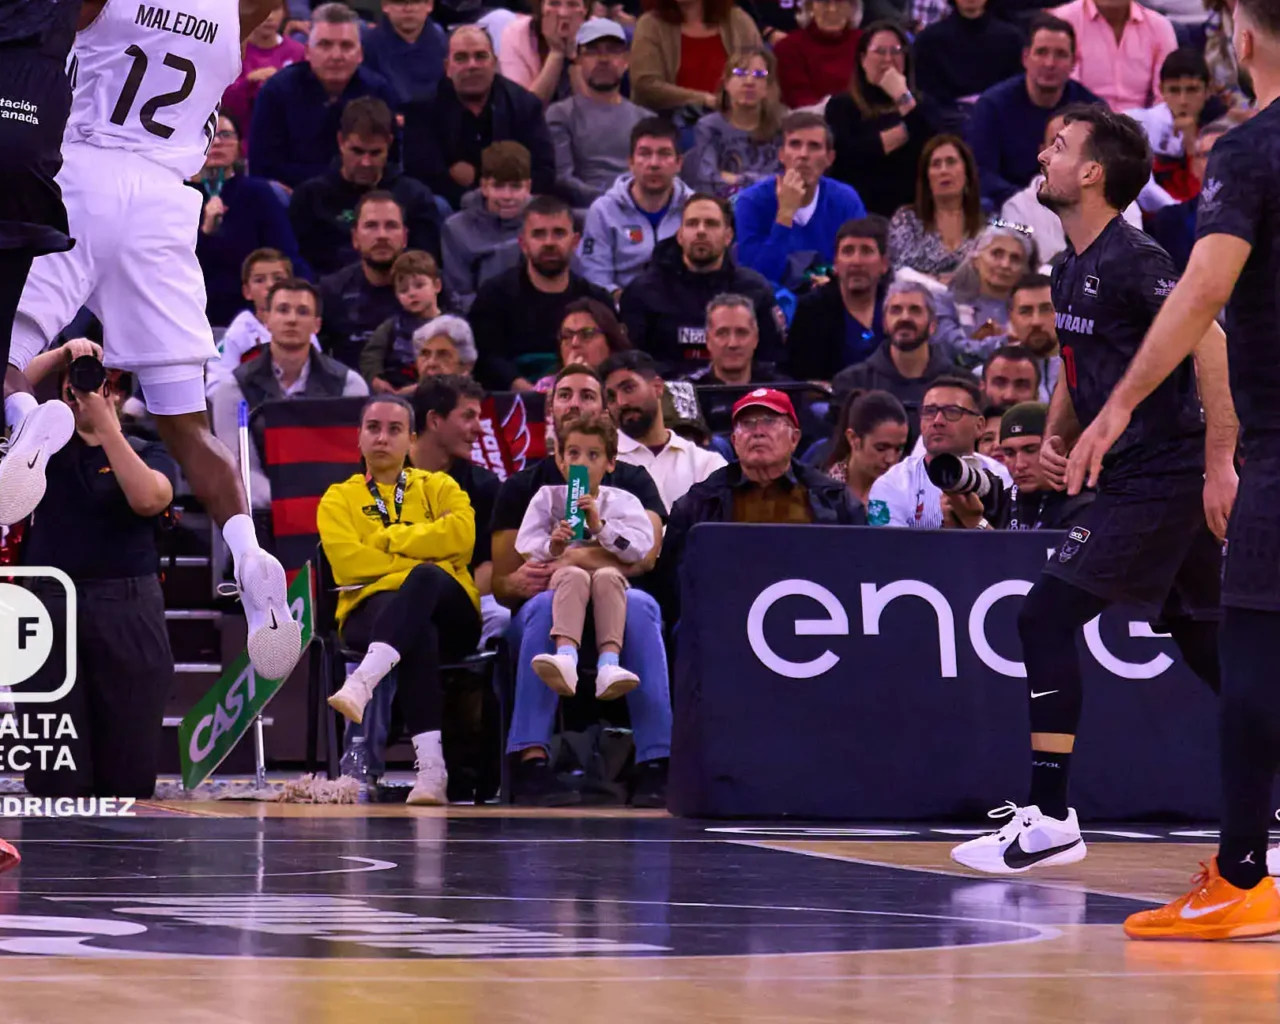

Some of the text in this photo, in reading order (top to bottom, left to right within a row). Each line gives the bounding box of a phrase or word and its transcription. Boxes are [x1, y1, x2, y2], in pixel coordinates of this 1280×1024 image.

[134, 4, 218, 44] MALEDON
[109, 44, 197, 139] 12
[1070, 531, 1083, 540] acb
